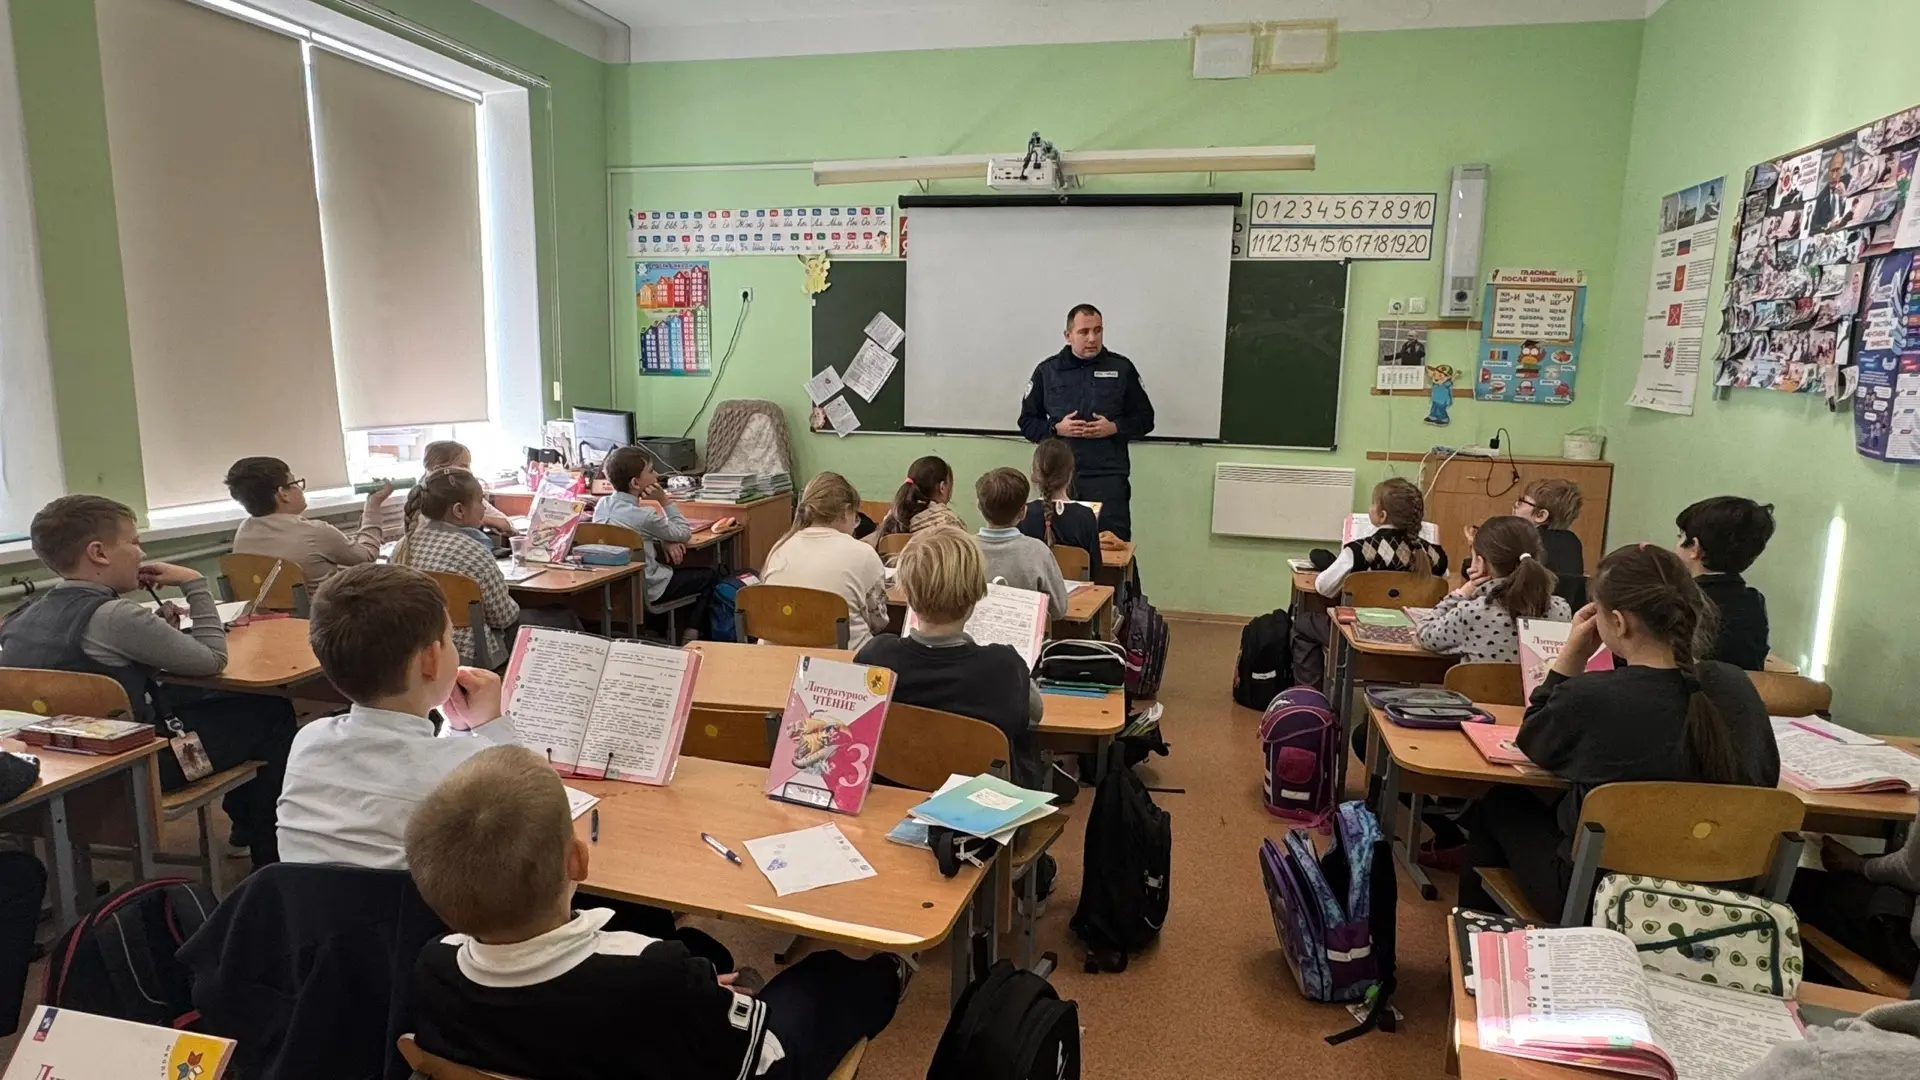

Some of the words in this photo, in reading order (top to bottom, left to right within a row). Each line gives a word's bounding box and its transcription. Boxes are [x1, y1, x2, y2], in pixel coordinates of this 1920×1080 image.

[1256, 200, 1268, 219] 0
[1272, 200, 1281, 219] 1
[1284, 200, 1296, 219] 2
[1301, 200, 1312, 219] 3
[1317, 200, 1328, 219] 4
[1334, 200, 1346, 219] 5
[1351, 200, 1363, 219] 6
[1368, 200, 1378, 219] 7
[1382, 200, 1394, 219] 8
[1398, 200, 1410, 219] 9
[1414, 200, 1431, 219] 10
[1252, 234, 1266, 253] 11
[1267, 234, 1282, 253] 12
[1284, 234, 1300, 253] 13
[1302, 234, 1317, 253] 14
[1320, 234, 1335, 253] 15
[1338, 234, 1352, 253] 16
[1355, 234, 1371, 253] 17
[1374, 234, 1388, 253] 18
[1390, 234, 1406, 253] 19
[1406, 234, 1428, 253] 20
[1539, 294, 1546, 302] А
[804, 680, 868, 702] Литературное
[812, 694, 856, 712] ЧТЕНИЕ
[839, 744, 870, 788] 3
